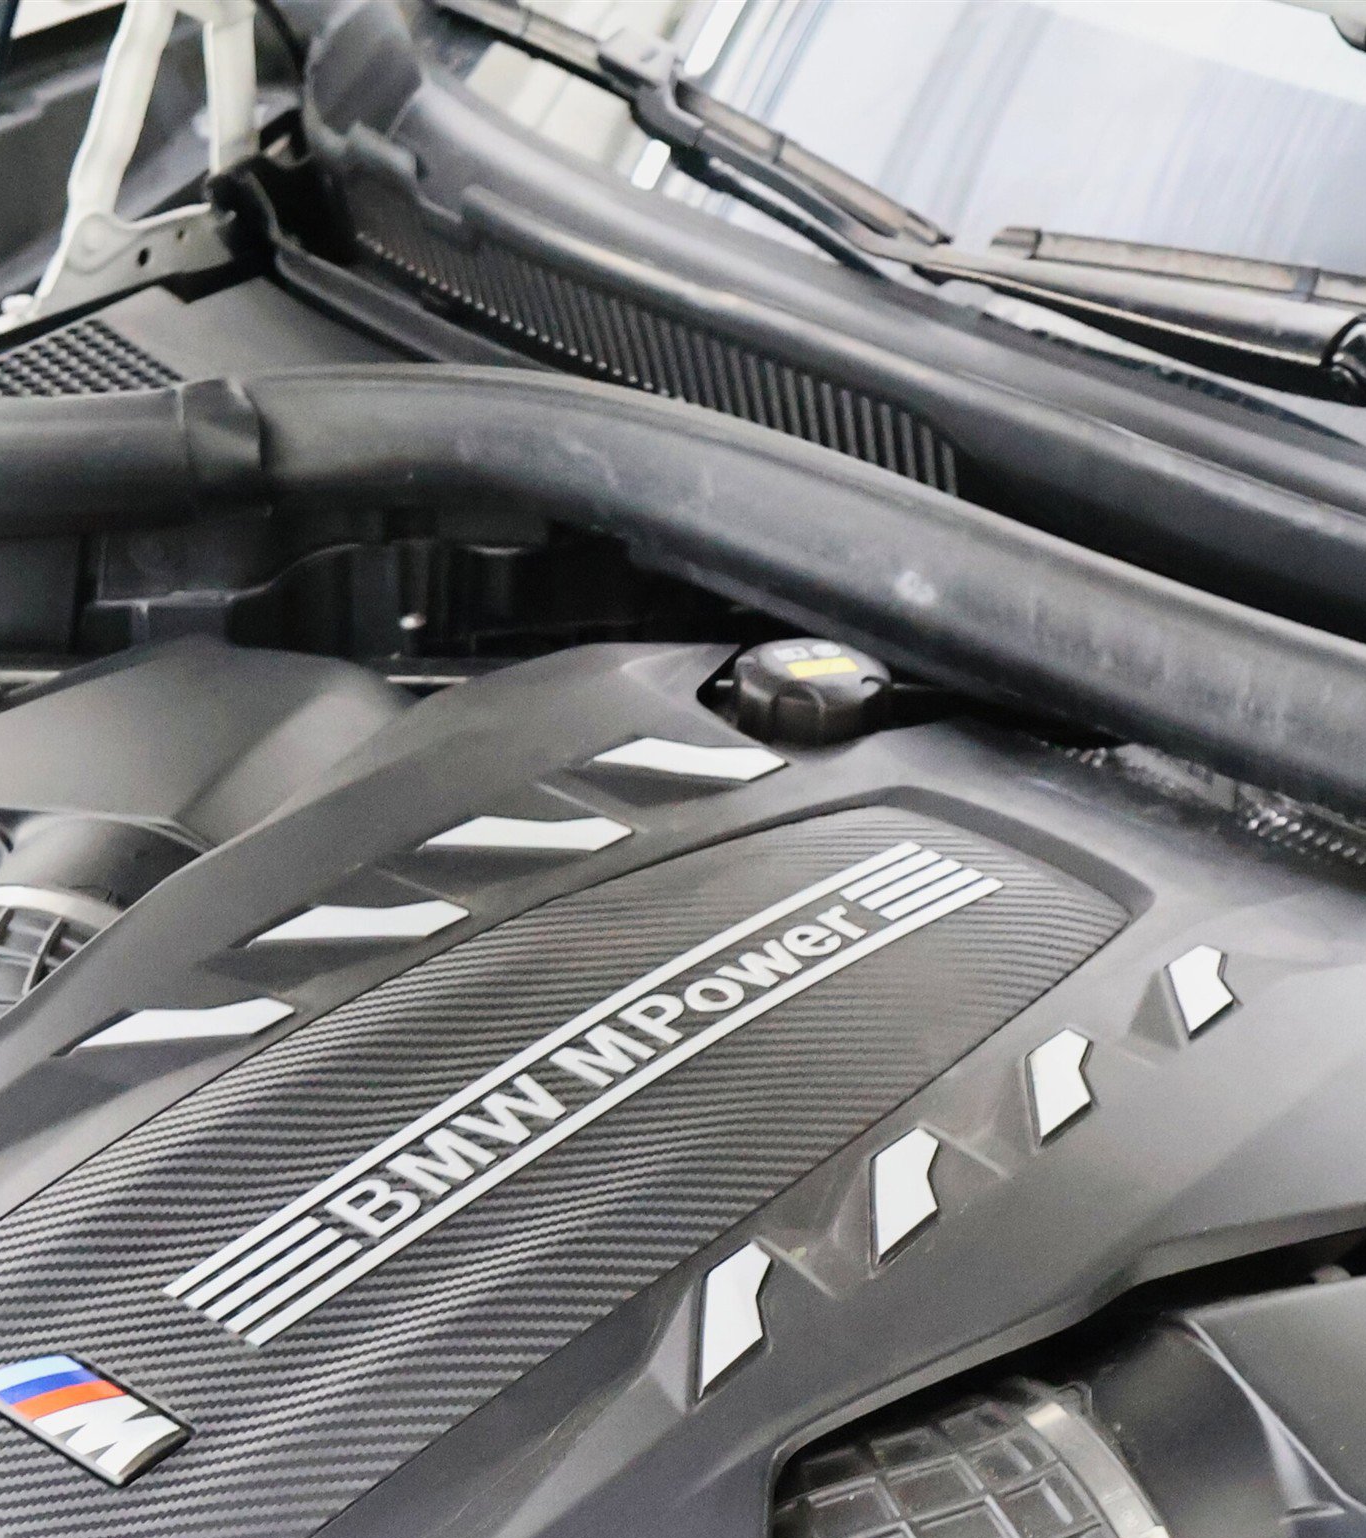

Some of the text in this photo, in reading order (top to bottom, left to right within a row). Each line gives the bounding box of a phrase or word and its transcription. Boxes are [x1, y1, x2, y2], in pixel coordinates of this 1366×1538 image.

[325, 904, 867, 1238] BMW MPower
[33, 1394, 181, 1476] M
